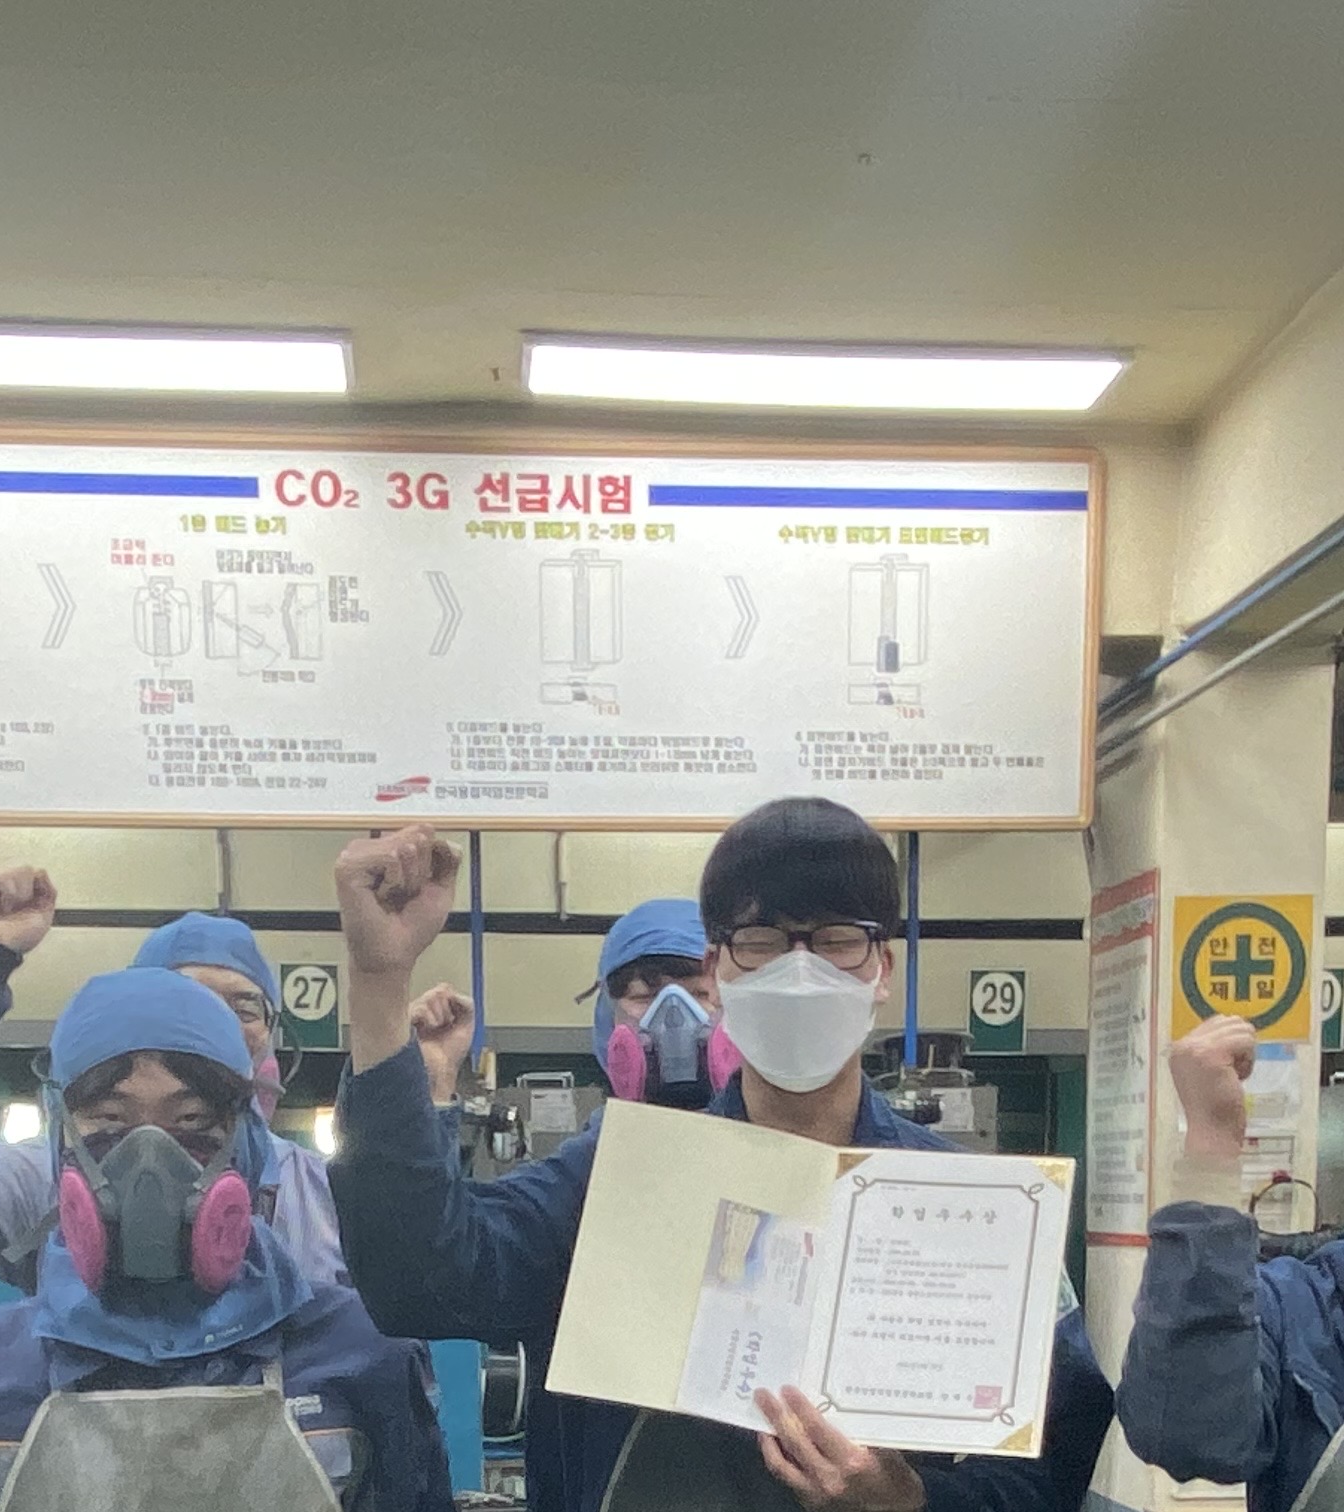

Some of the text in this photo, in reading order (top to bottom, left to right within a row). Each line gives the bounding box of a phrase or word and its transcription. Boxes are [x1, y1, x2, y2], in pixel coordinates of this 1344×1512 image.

[387, 472, 450, 510] 3G
[473, 472, 633, 515] 선급시험
[293, 976, 328, 1009] 27
[981, 981, 1016, 1014] 29
